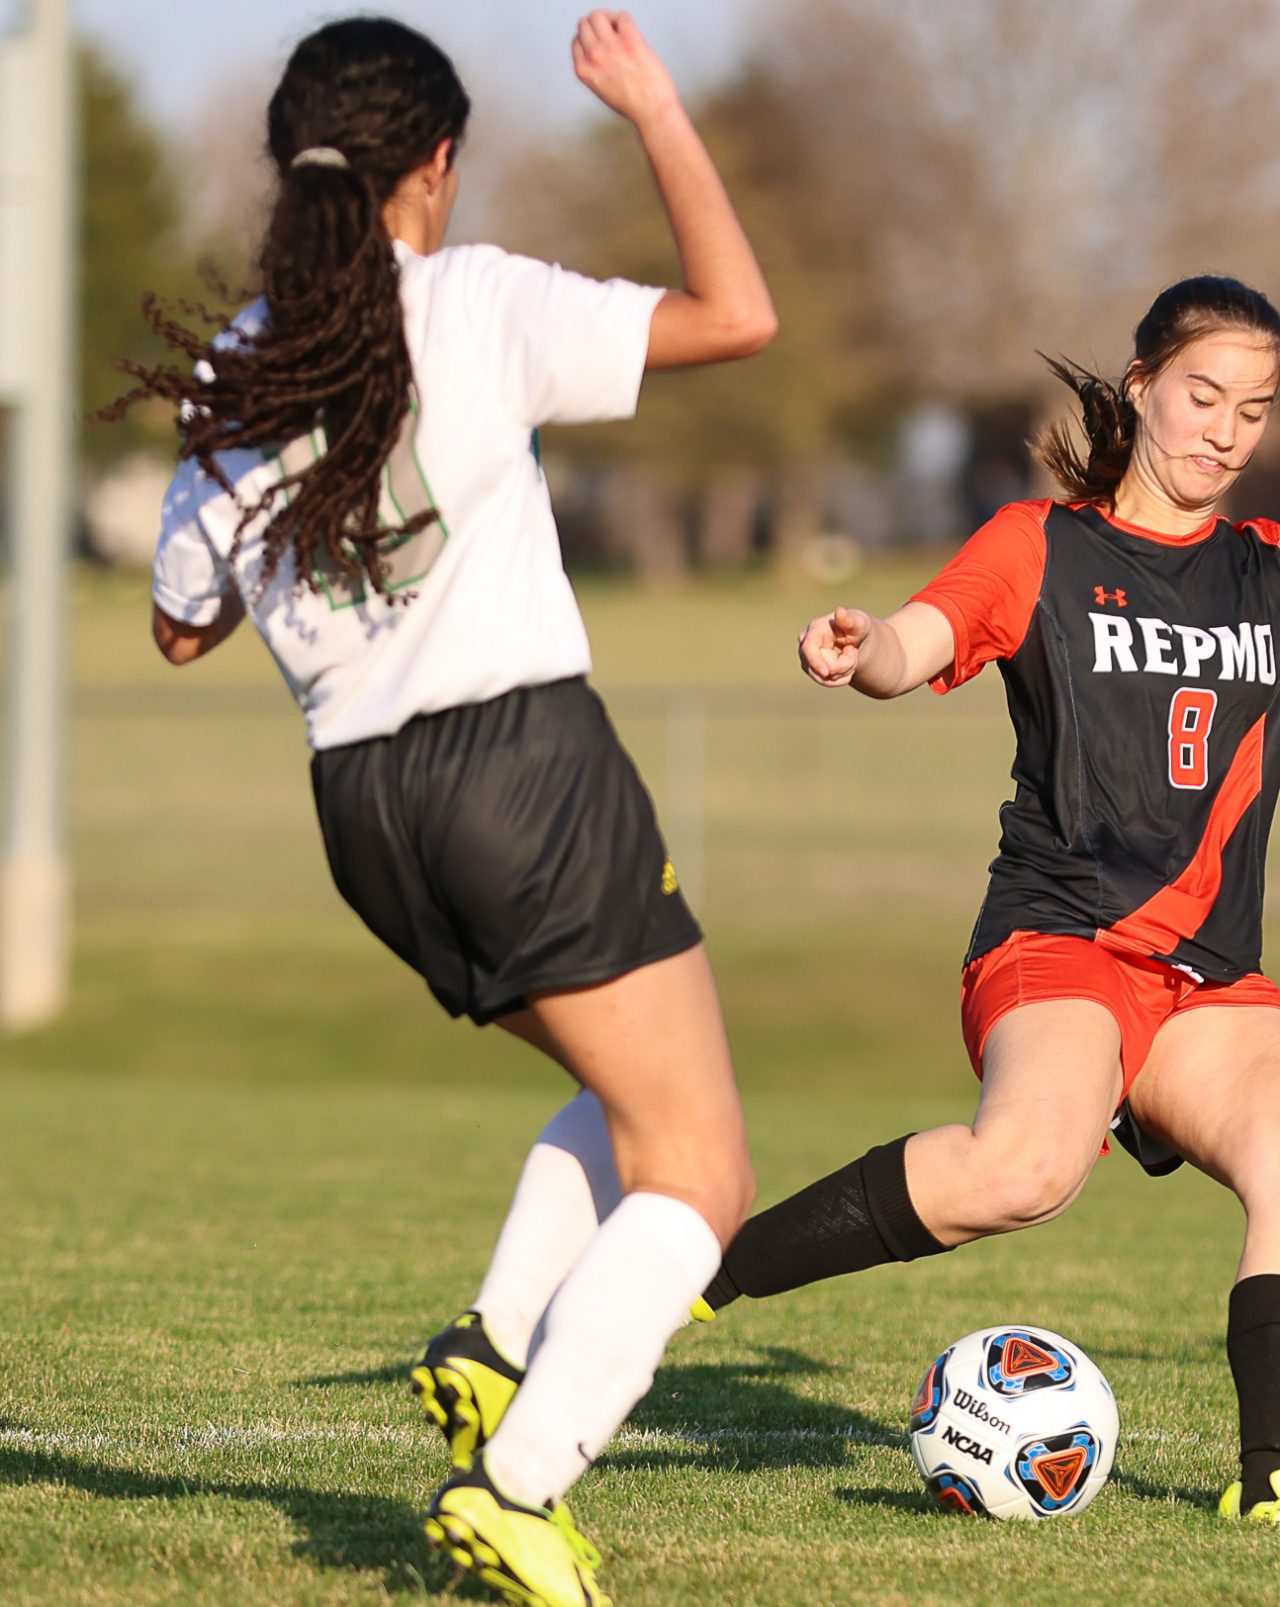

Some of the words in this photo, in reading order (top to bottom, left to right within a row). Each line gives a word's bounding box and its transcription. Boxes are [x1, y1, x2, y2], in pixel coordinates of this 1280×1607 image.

[1088, 612, 1276, 685] REPMO
[1168, 686, 1218, 790] 8
[953, 1388, 1011, 1435] Wilson
[941, 1425, 994, 1466] NCAA
